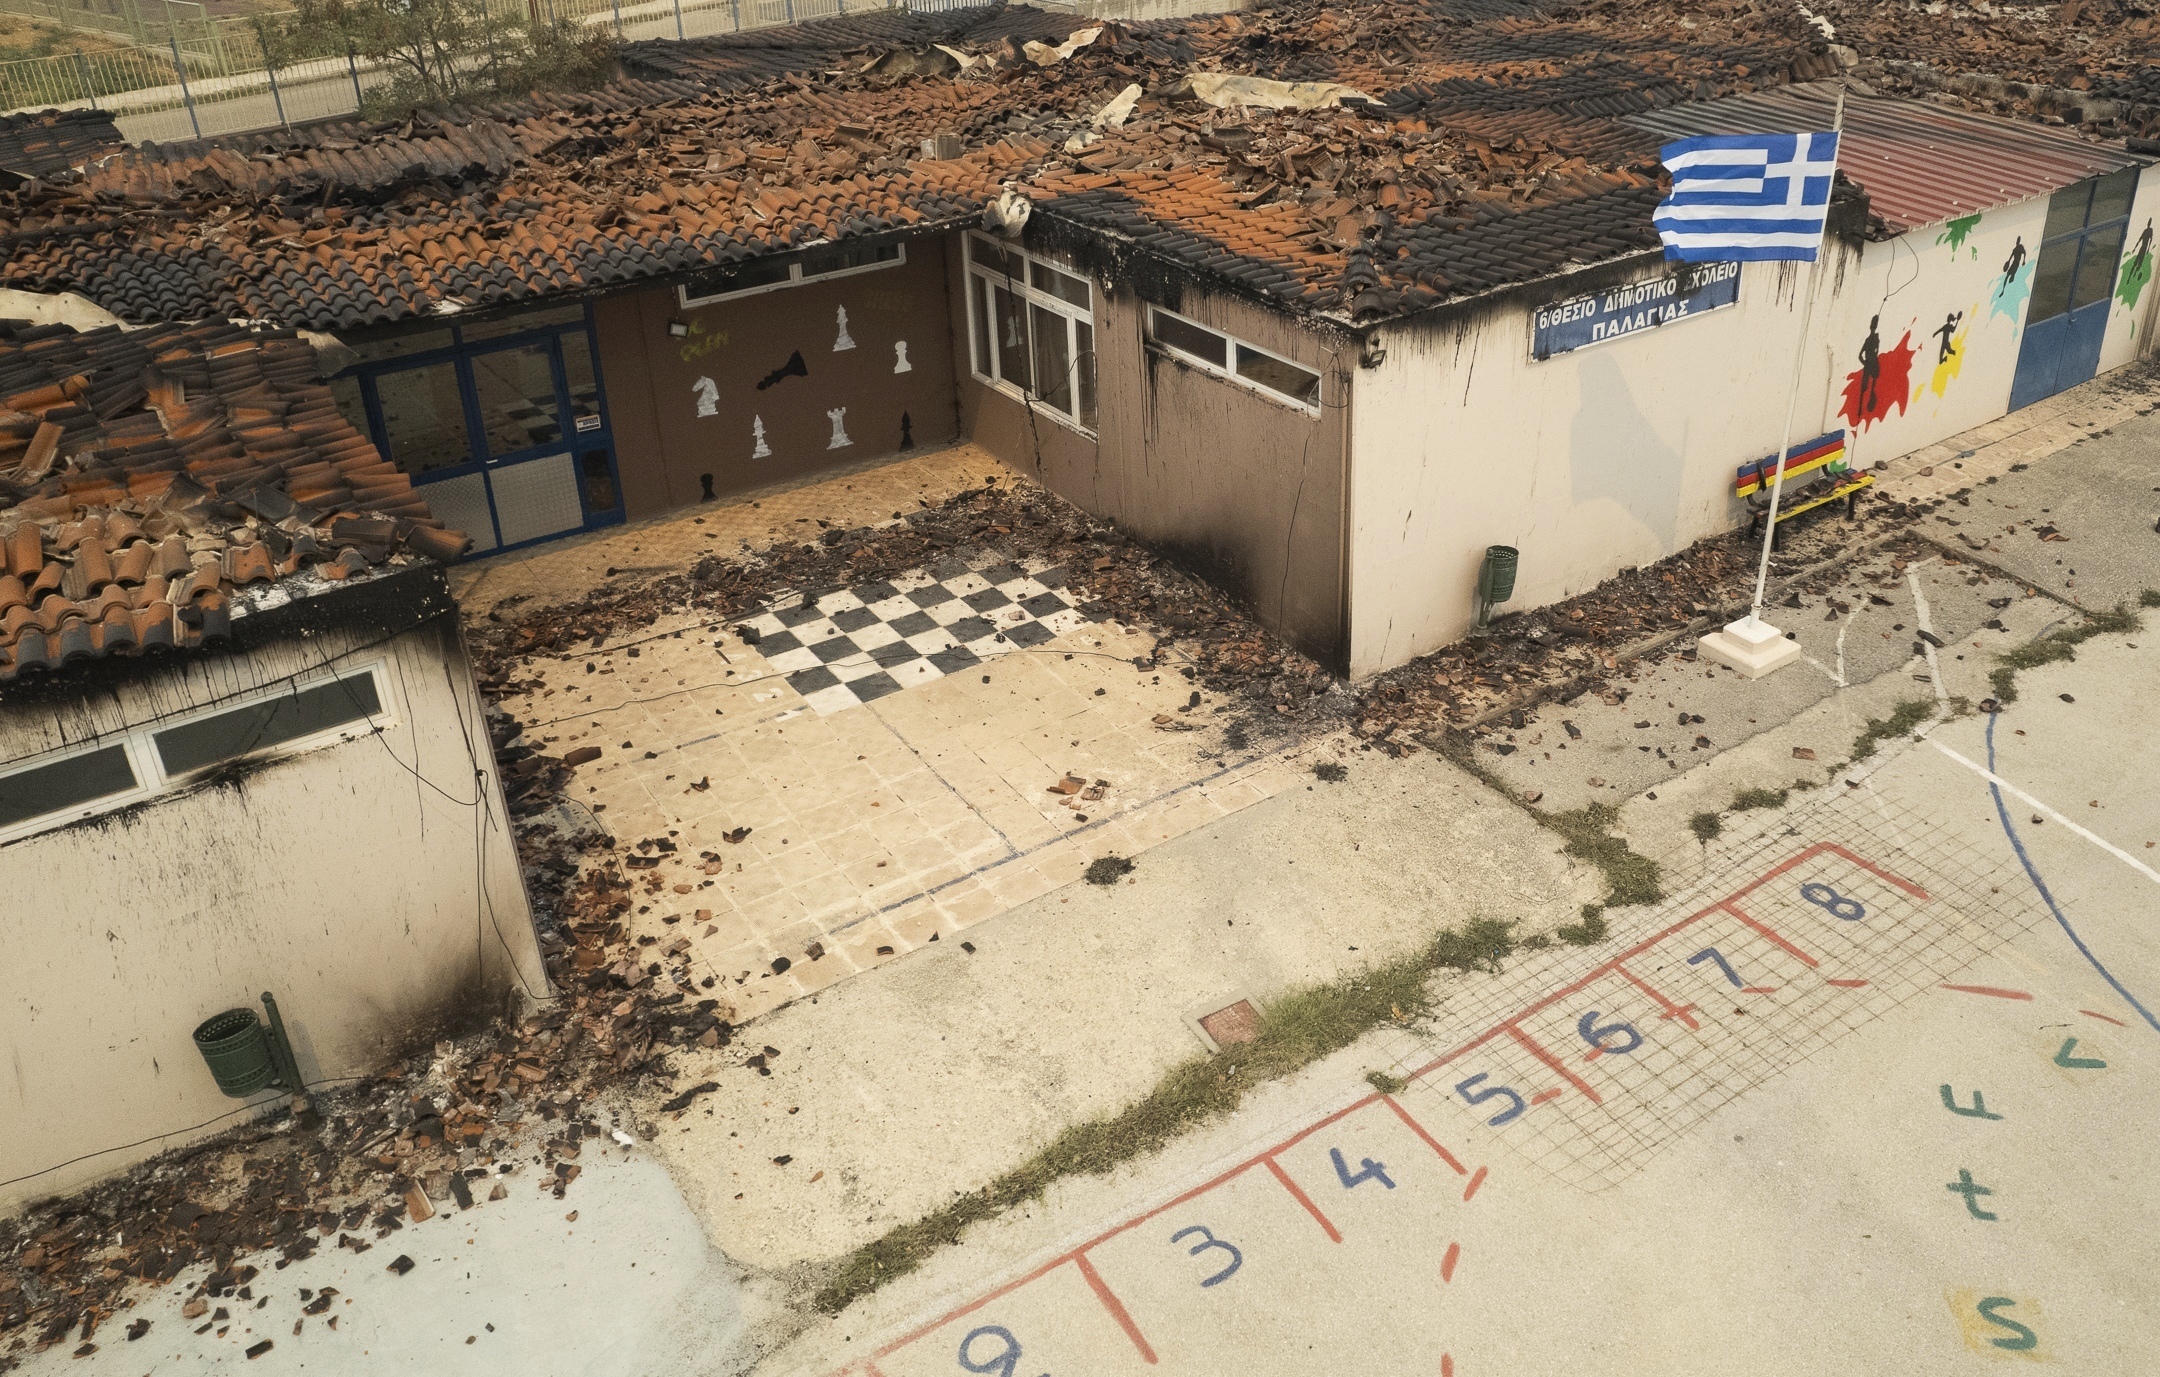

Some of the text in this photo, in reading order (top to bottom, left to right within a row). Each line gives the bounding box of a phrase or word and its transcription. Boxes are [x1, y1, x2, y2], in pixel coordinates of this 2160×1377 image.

[1603, 278, 1677, 313] ΔΗΜΟΤΙΚΟ
[1592, 299, 1690, 341] ΠΑΛΑΓΙΑΣ
[1800, 882, 1866, 921] 8
[1687, 947, 1743, 988] 7
[1578, 1010, 1644, 1055] 6
[1455, 1072, 1528, 1127] 5
[1330, 1147, 1397, 1190] 4
[1171, 1225, 1243, 1287] 3
